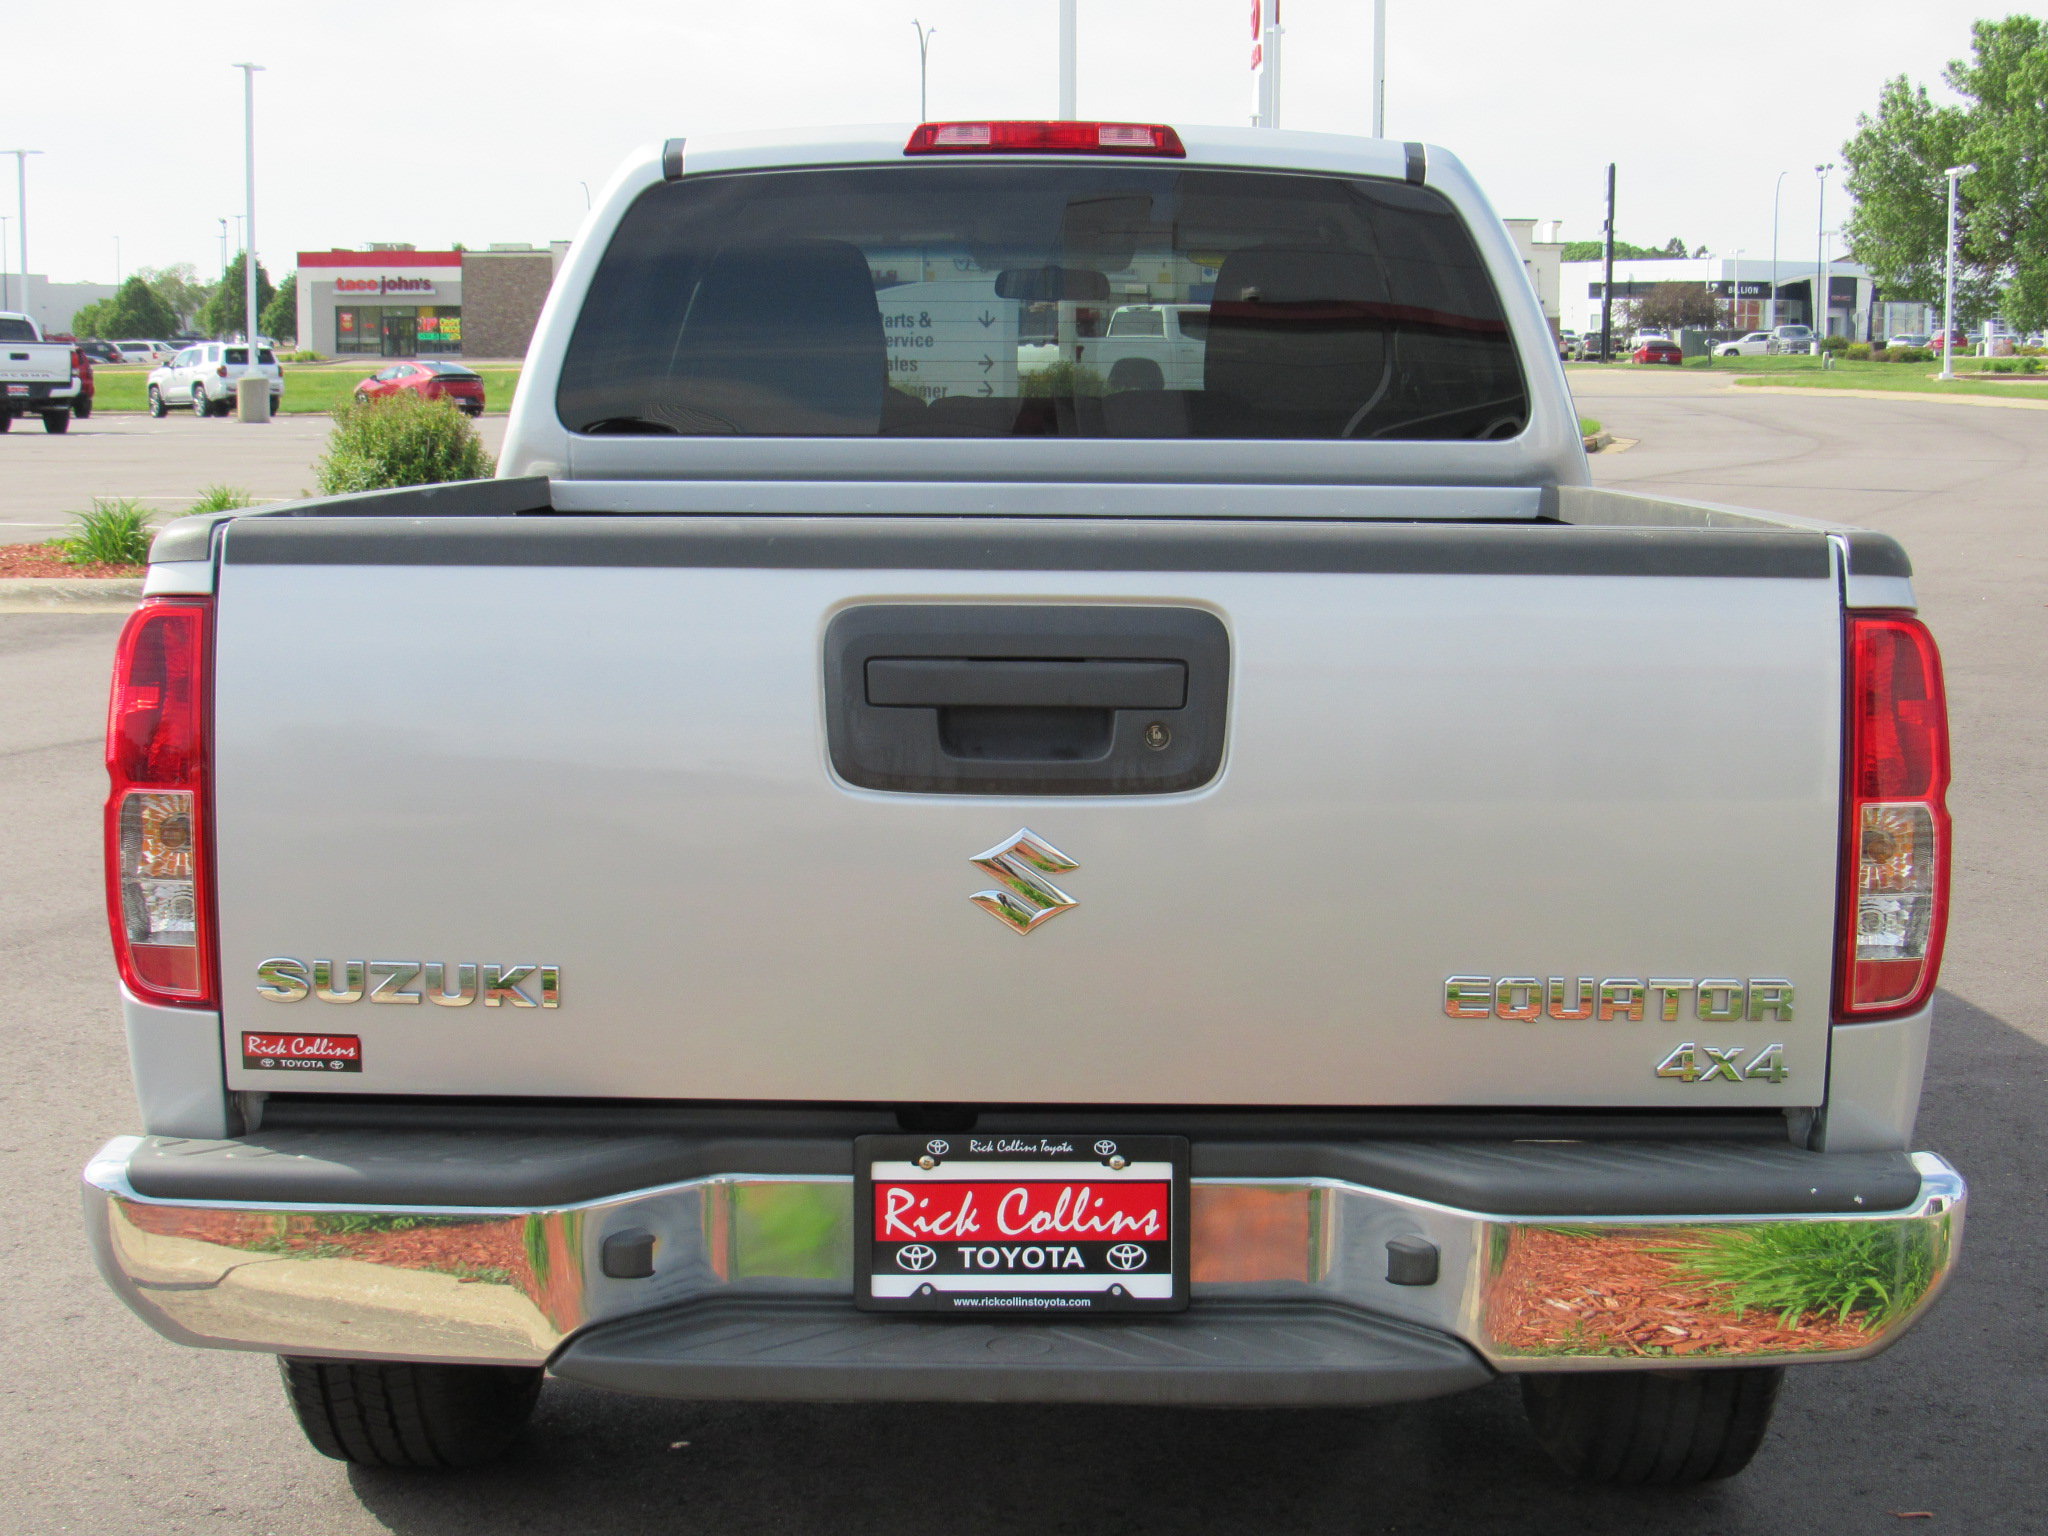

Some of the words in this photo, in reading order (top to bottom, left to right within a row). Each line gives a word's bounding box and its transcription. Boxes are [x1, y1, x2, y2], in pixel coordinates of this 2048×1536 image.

[336, 277, 378, 291] taco
[380, 276, 432, 295] john's
[1728, 286, 1759, 295] BLION
[919, 311, 931, 328] &
[887, 331, 934, 348] ervice
[888, 355, 918, 372] ales
[256, 957, 561, 1008] SUZUKI
[1444, 975, 1794, 1023] EQUATOR
[248, 1036, 287, 1054] Rick
[291, 1037, 356, 1056] Collins
[280, 1059, 324, 1068] TOYOTA
[969, 1139, 994, 1152] Rick
[997, 1139, 1037, 1152] Collins
[1040, 1139, 1073, 1155] Toyota
[884, 1187, 980, 1237] Rick
[997, 1186, 1160, 1236] Collins
[957, 1246, 1085, 1269] TOYOTA
[953, 1297, 1091, 1309] www.rickcollinstoyota.com
